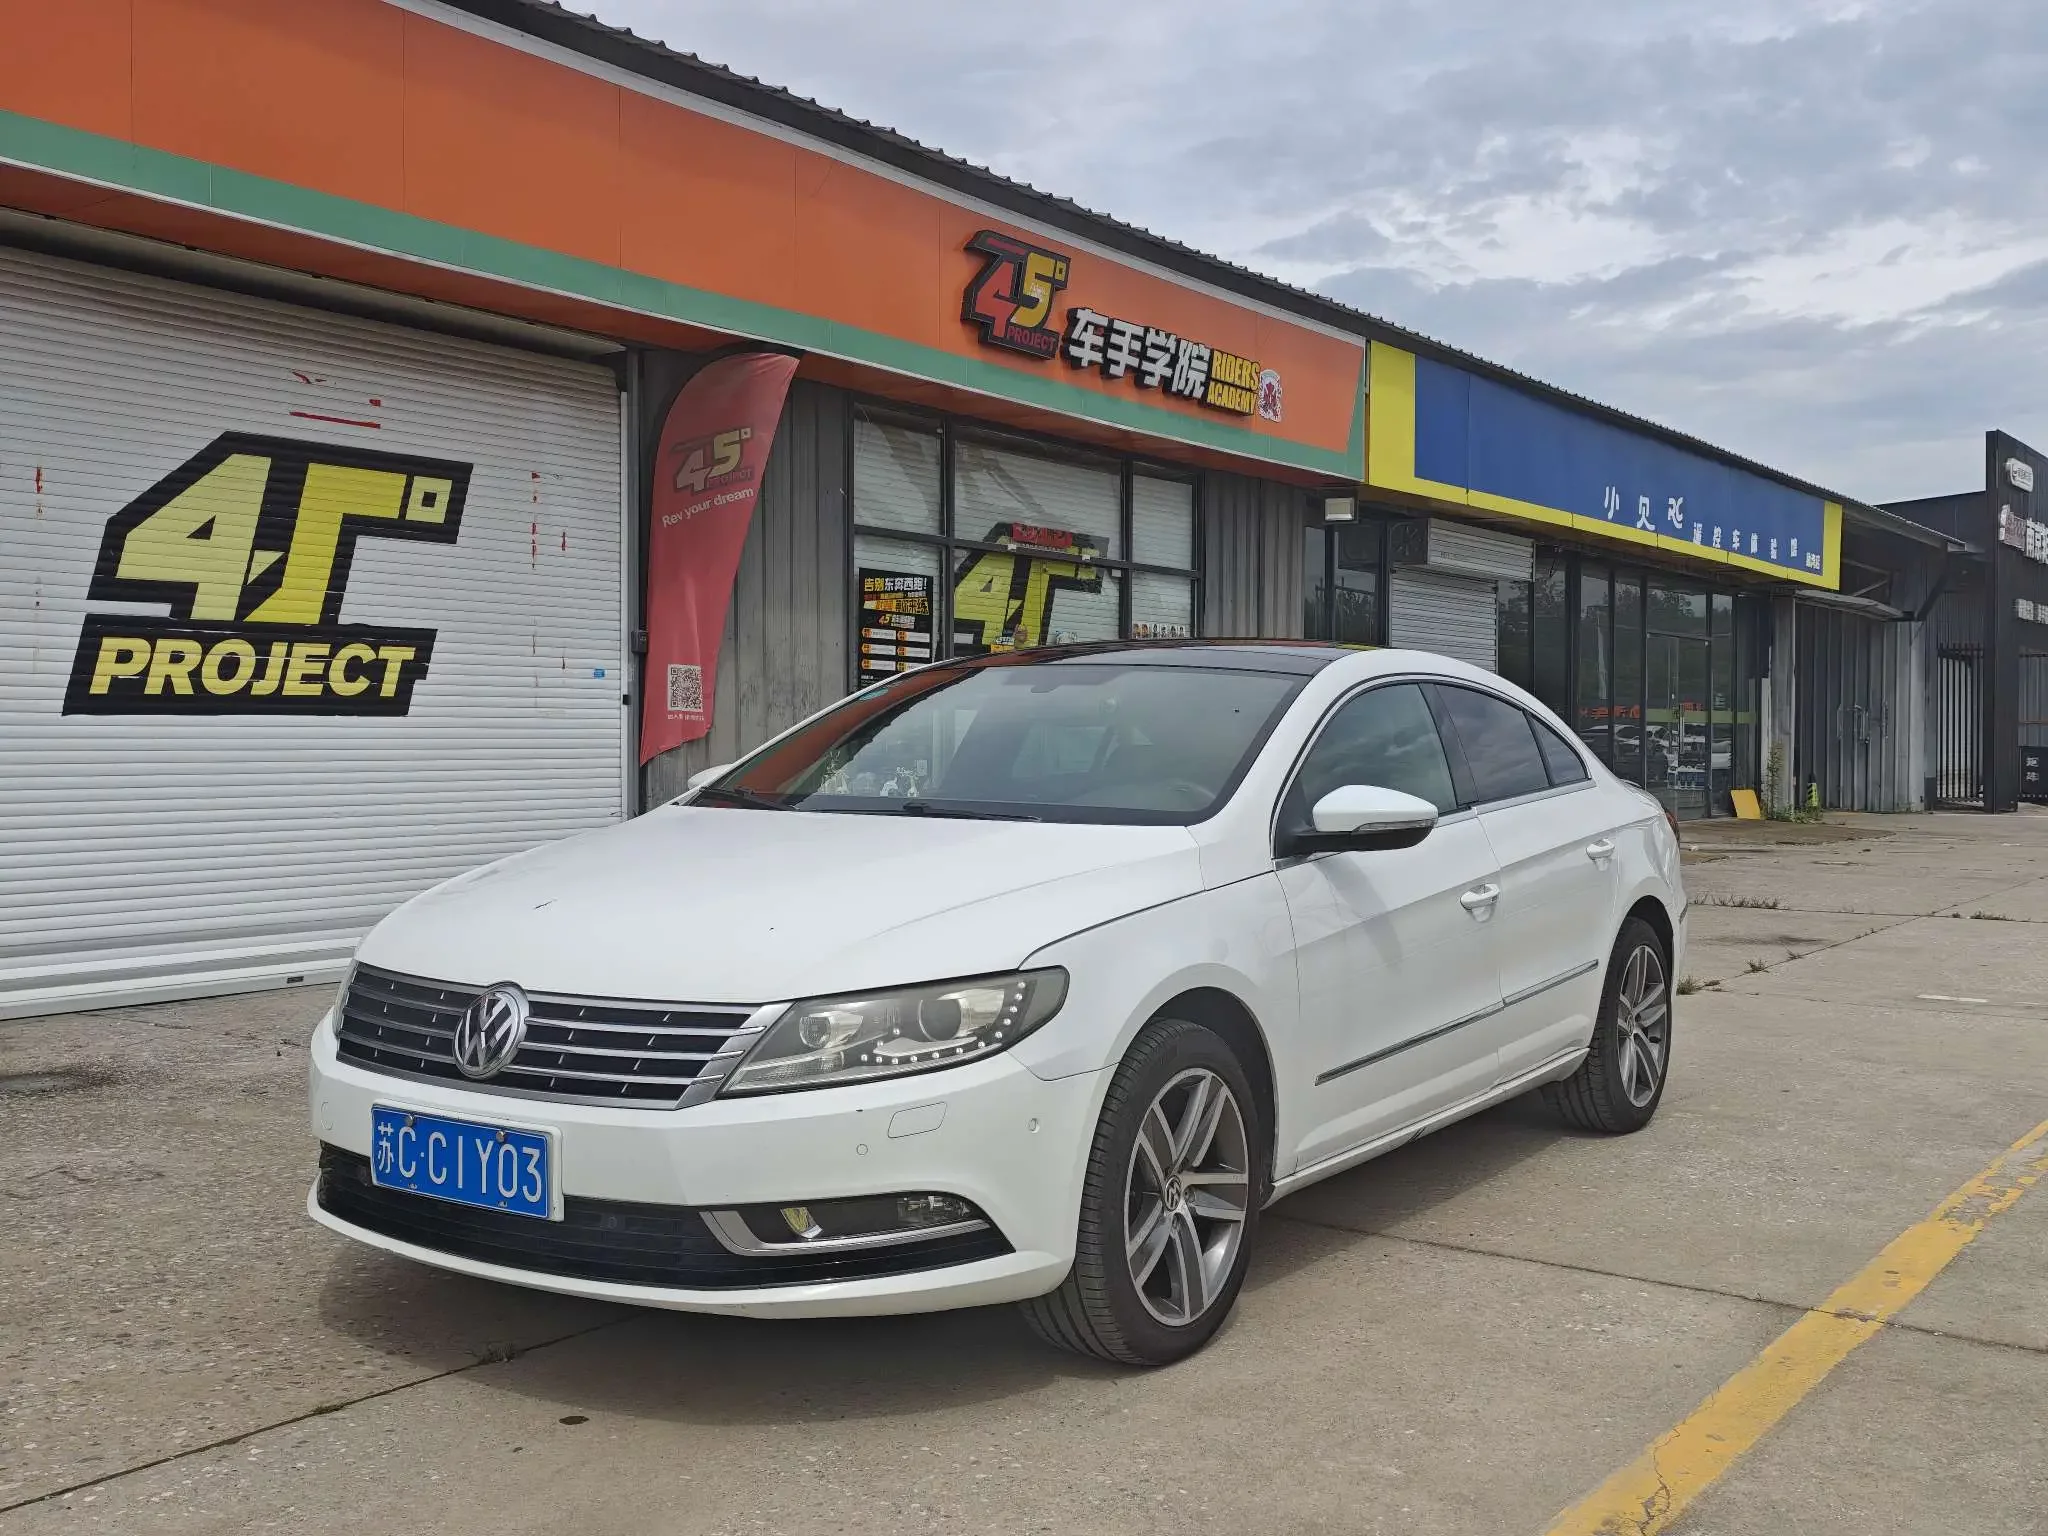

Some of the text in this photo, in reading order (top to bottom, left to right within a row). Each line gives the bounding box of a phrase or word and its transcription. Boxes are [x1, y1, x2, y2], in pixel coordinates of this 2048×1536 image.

[1007, 325, 1056, 351] PROJECT
[1069, 308, 1212, 399] 车手学院
[1211, 350, 1260, 391] RIDERS
[1207, 380, 1257, 414] ACADEMY
[662, 487, 754, 528] Rev your dream
[88, 636, 416, 698] PROJECT
